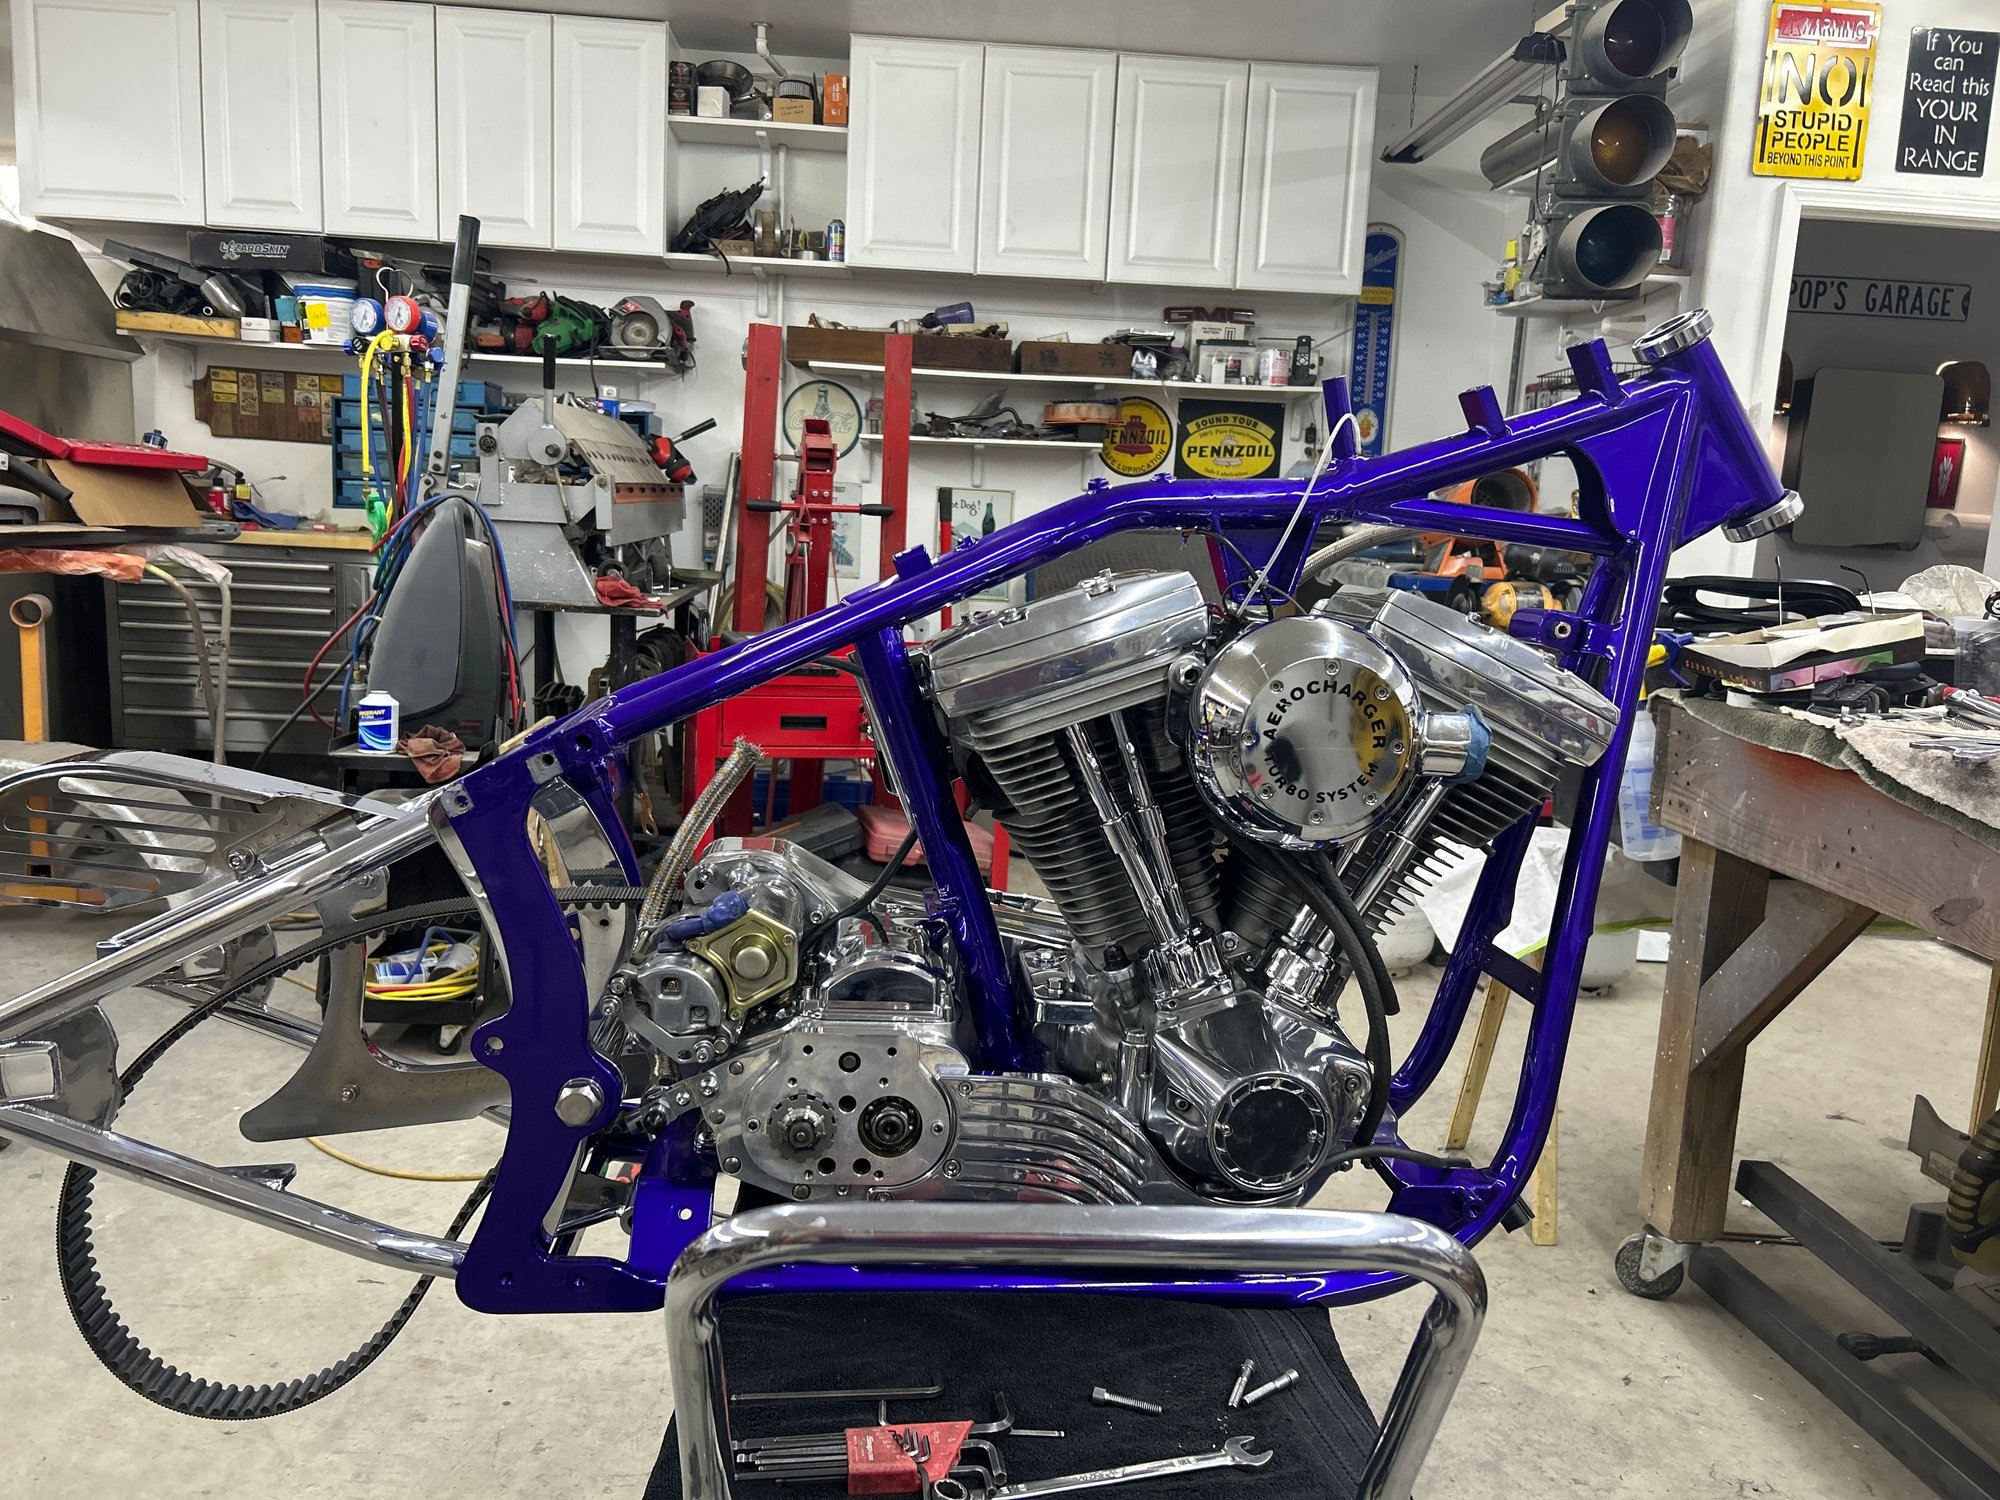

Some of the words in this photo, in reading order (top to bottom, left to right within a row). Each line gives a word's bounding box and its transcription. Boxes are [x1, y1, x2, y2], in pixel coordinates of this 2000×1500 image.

[1800, 16, 1867, 41] WARNING
[1926, 31, 1939, 51] If
[1948, 34, 1984, 55] You
[1934, 56, 1964, 72] can
[1778, 52, 1857, 107] NO
[1909, 72, 1955, 94] Read
[1962, 77, 1990, 97] this
[1774, 110, 1852, 131] STUPID
[1916, 97, 1978, 122] YOUR
[1771, 131, 1850, 152] PEOPLE
[1934, 124, 1957, 145] IN
[1767, 152, 1802, 166] BEYOND
[1804, 154, 1823, 168] THIS
[1824, 155, 1850, 169] POINT
[1903, 147, 1979, 172] RANGE
[1865, 283, 1954, 316] GARAGE
[1164, 306, 1256, 326] GMC
[1195, 416, 1229, 430] SOUND
[1232, 416, 1259, 429] YOUR
[1117, 449, 1166, 474] LUBRICATION
[1187, 445, 1273, 458] PENNZOIL
[960, 499, 981, 517] Dog!
[1685, 660, 1725, 678] GASKETS
[1263, 680, 1386, 750] AEROCHARGER
[1264, 755, 1310, 801] TURBO
[1315, 762, 1379, 804] SYSTEM
